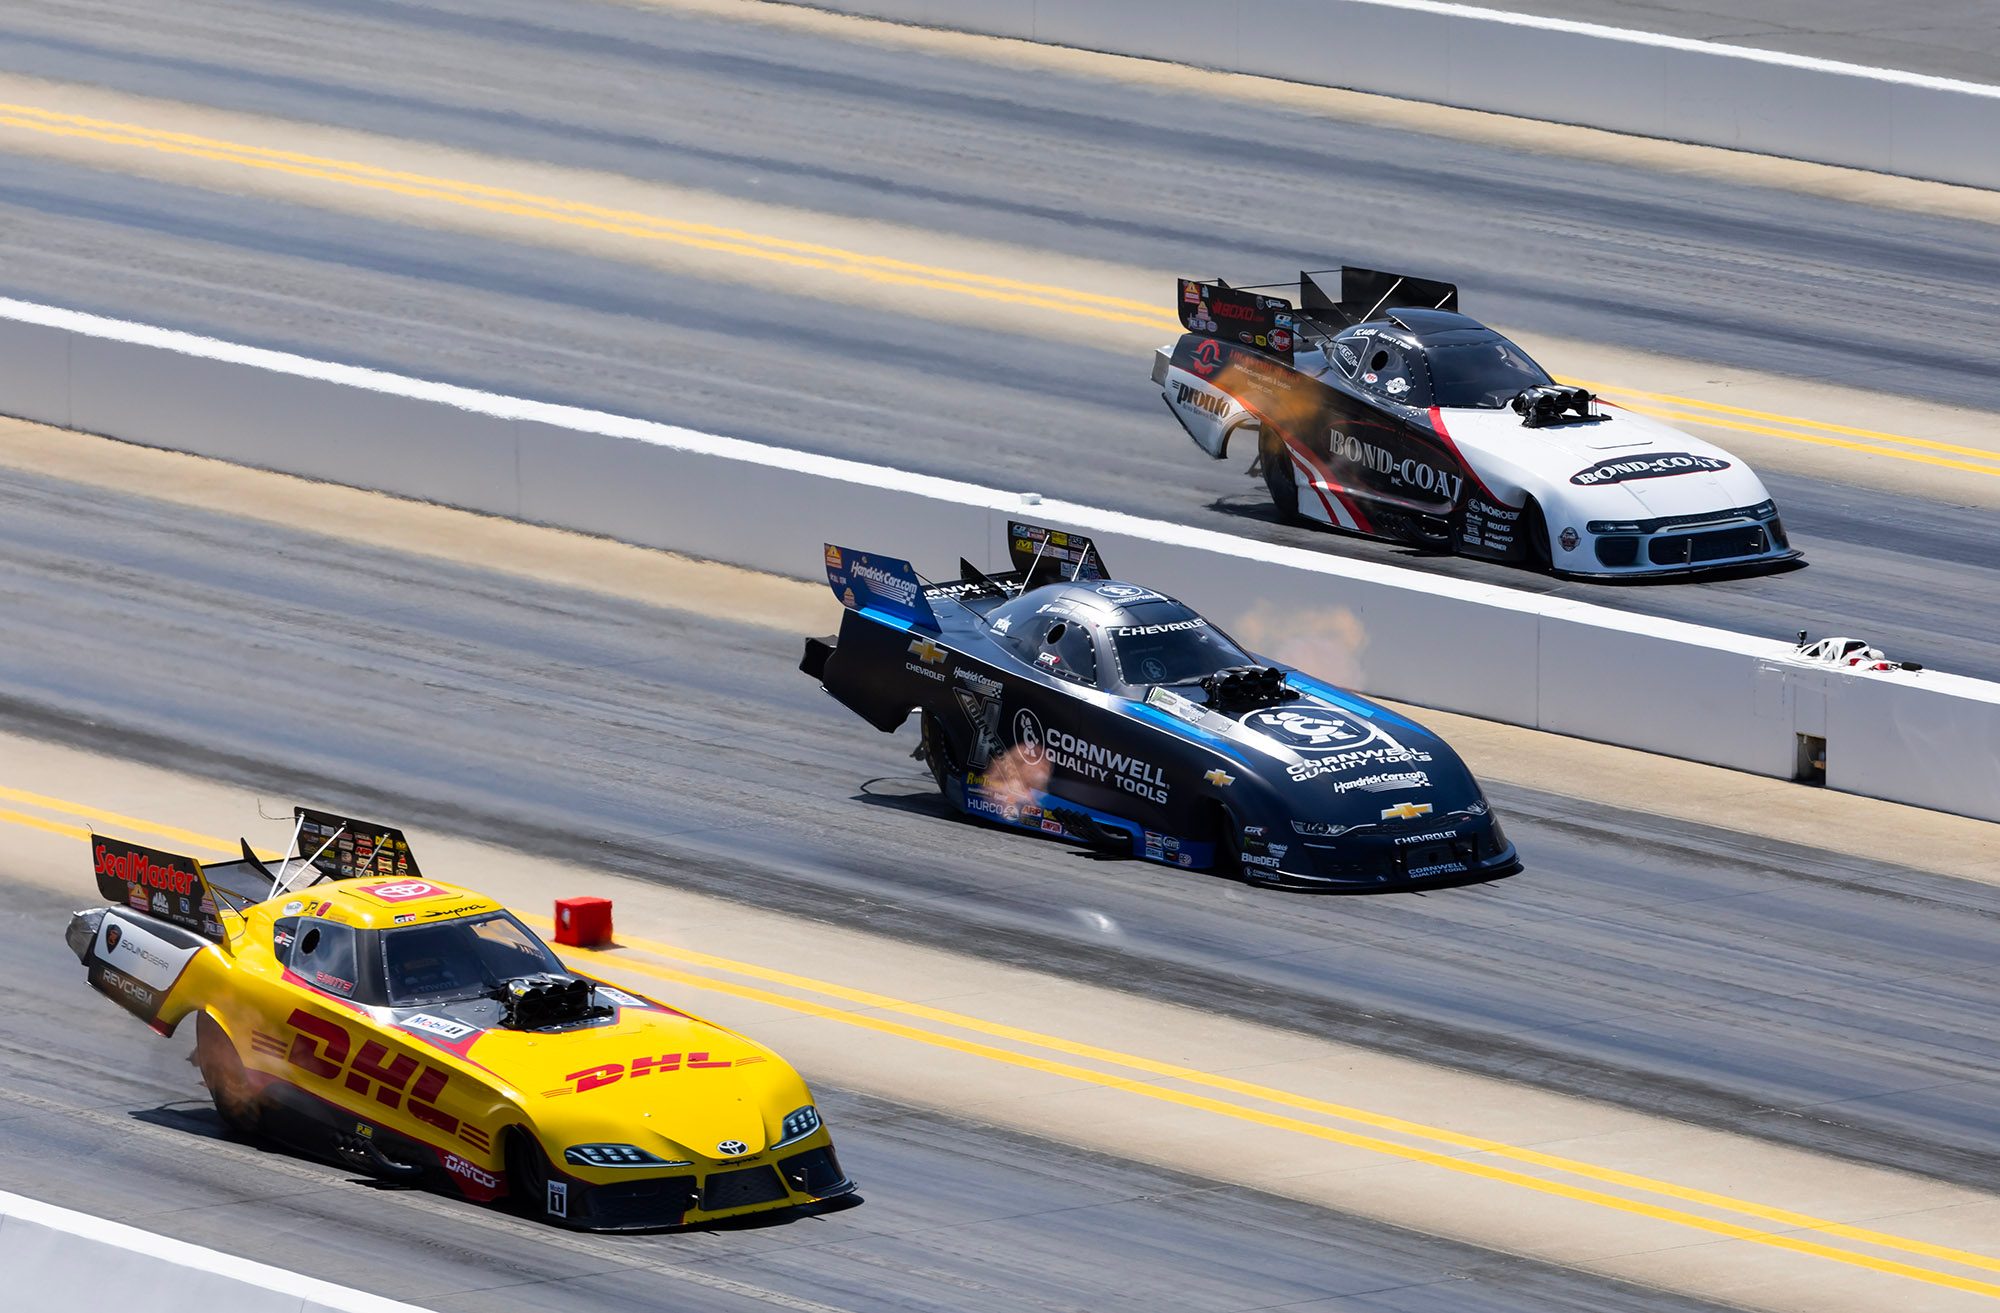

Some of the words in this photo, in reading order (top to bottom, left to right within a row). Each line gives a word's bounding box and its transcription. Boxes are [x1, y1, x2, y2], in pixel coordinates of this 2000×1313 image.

[1177, 383, 1231, 419] pronto
[1329, 428, 1463, 502] BOND-COAT
[1576, 456, 1719, 485] BOND-COAT
[1486, 521, 1511, 533] MOOG
[850, 560, 918, 594] HendrickCars.com
[905, 662, 946, 682] CHEVROLET
[1047, 728, 1167, 788] CORNWELL
[1286, 747, 1430, 776] CORNWELL
[1292, 760, 1369, 782] QUALITY
[1375, 753, 1433, 765] TOOLS
[1045, 747, 1109, 783] QUALITY
[1115, 774, 1169, 805] TOOLS
[1333, 770, 1428, 794] HendrickCars.com
[967, 798, 1004, 816] HURCO
[1394, 830, 1458, 846] CHEVROLET
[95, 844, 194, 896] SealMaster
[1408, 861, 1465, 875] CORNWELL
[1410, 869, 1442, 879] QUALITY
[394, 914, 416, 925] GR
[421, 904, 489, 918] Supra
[102, 969, 153, 1007] REVCHEM
[411, 1016, 449, 1035] Mobil
[286, 1007, 461, 1135] DHL
[565, 1052, 733, 1094] DHL
[444, 1154, 498, 1189] DAYCO
[553, 1194, 560, 1211] 1
